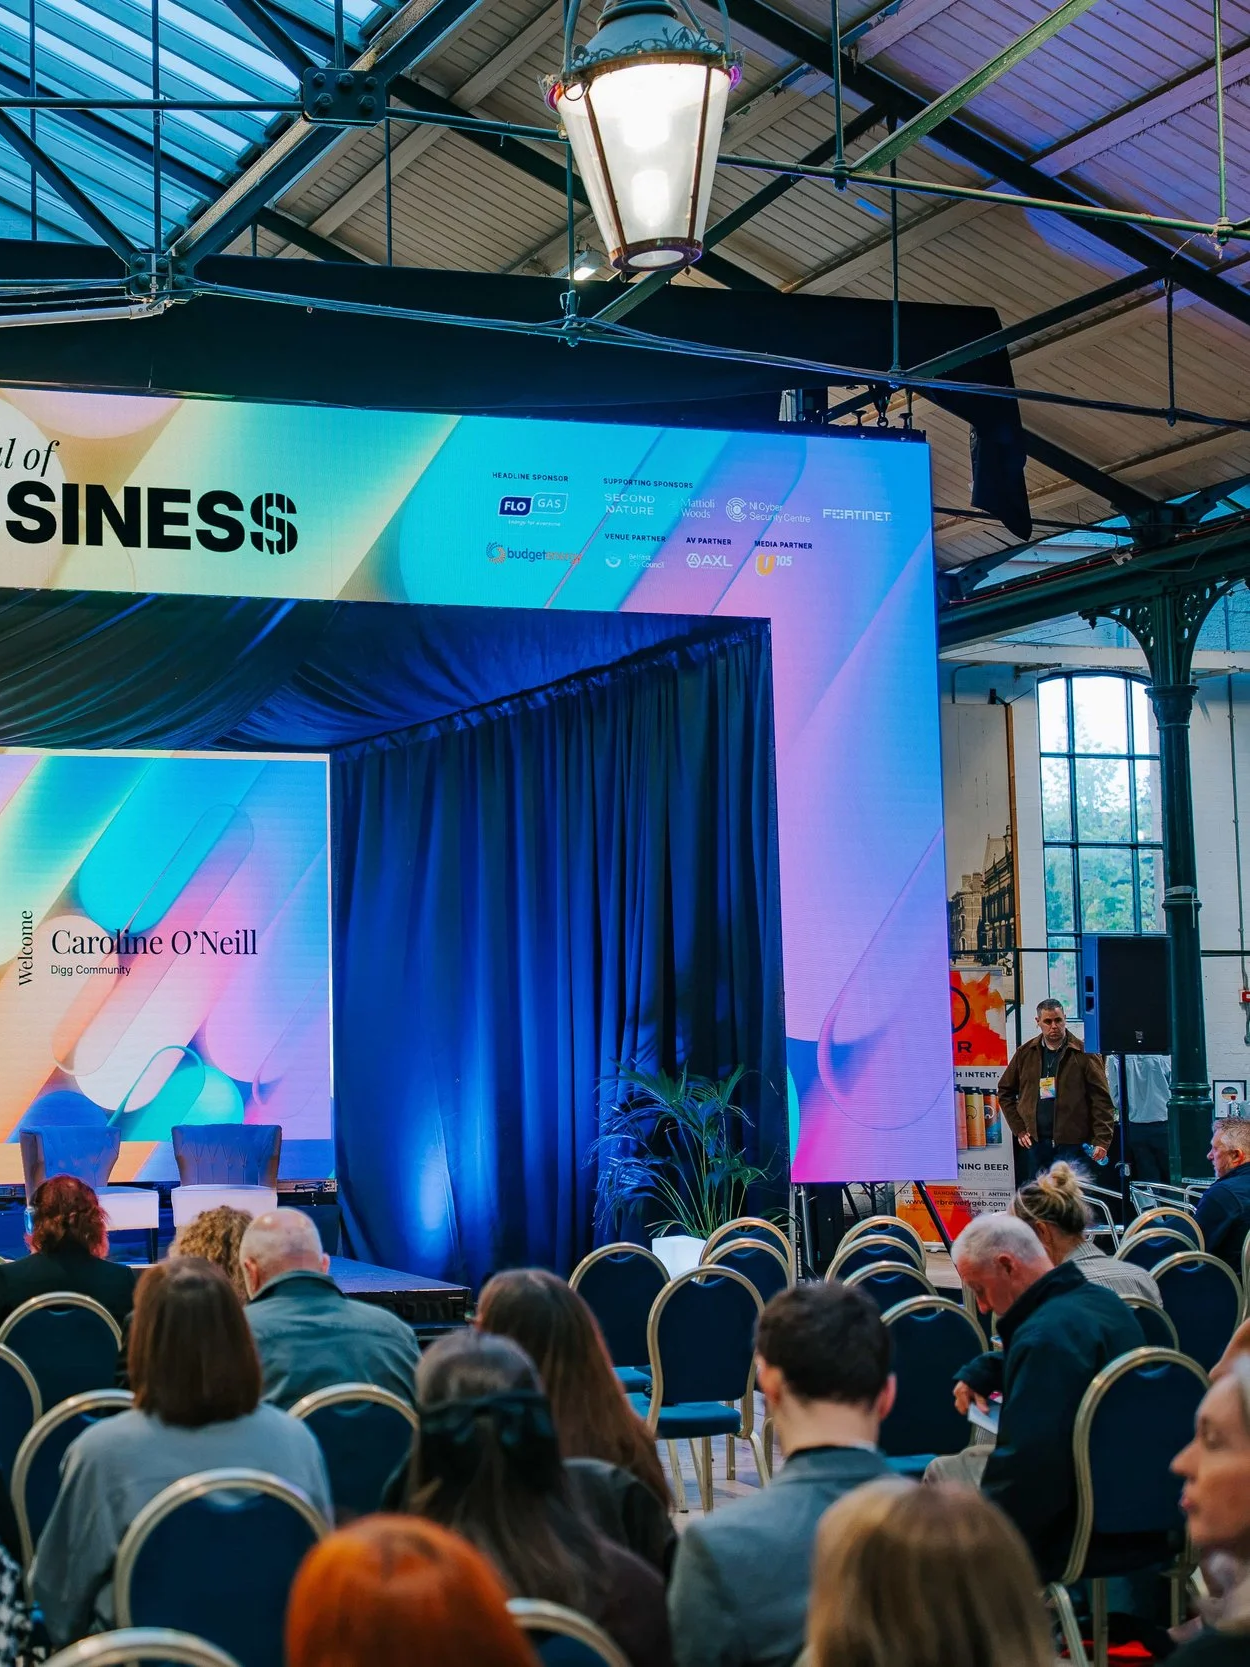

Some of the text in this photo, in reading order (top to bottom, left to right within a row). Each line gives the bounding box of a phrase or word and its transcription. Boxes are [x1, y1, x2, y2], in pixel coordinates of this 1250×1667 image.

[23, 440, 60, 478] of
[492, 472, 569, 482] HEADLINE SPONSOR
[603, 478, 694, 489] SUPPORTING SPONSORS
[604, 493, 655, 504] SECOND
[680, 498, 715, 509] Mattioli
[504, 498, 561, 512] FLO GAS
[605, 505, 655, 516] NATURE
[749, 502, 783, 514] NI Cyber
[681, 508, 711, 519] Woods
[749, 511, 811, 523] Security Centre
[605, 533, 666, 542] VENUE PARTNER
[698, 537, 732, 545] PARTNER
[754, 540, 813, 550] MEDIA PARTNER
[700, 555, 733, 567] AXL
[51, 928, 258, 955] Caroline O’Neill
[18, 910, 33, 986] Welcome
[50, 964, 131, 977] Digg Community
[984, 1163, 1009, 1171] BEER
